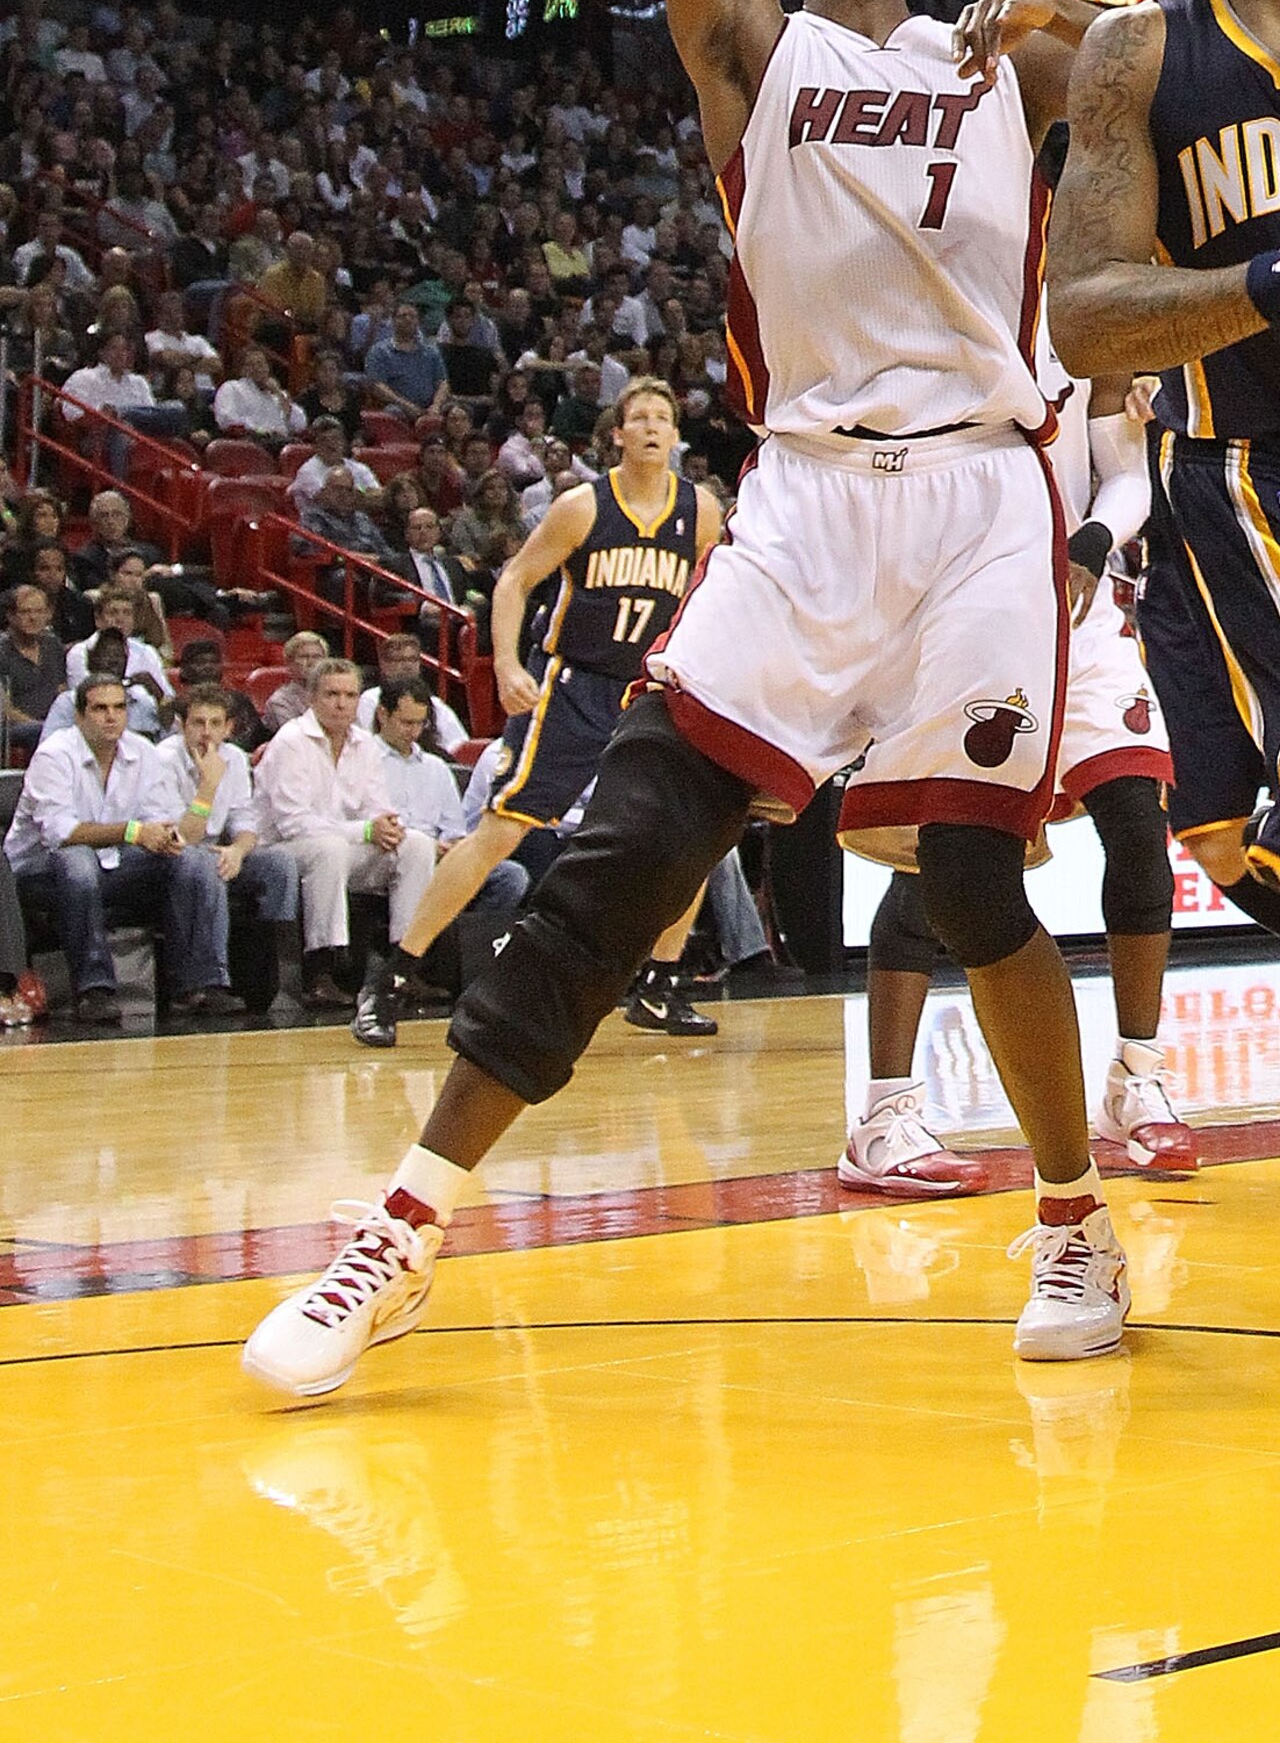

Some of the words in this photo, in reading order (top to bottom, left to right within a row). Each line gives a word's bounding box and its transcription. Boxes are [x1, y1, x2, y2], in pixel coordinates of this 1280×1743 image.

[789, 77, 997, 150] HEAT
[918, 162, 958, 230] 1
[584, 546, 689, 599] INDIANA
[612, 596, 656, 644] 17
